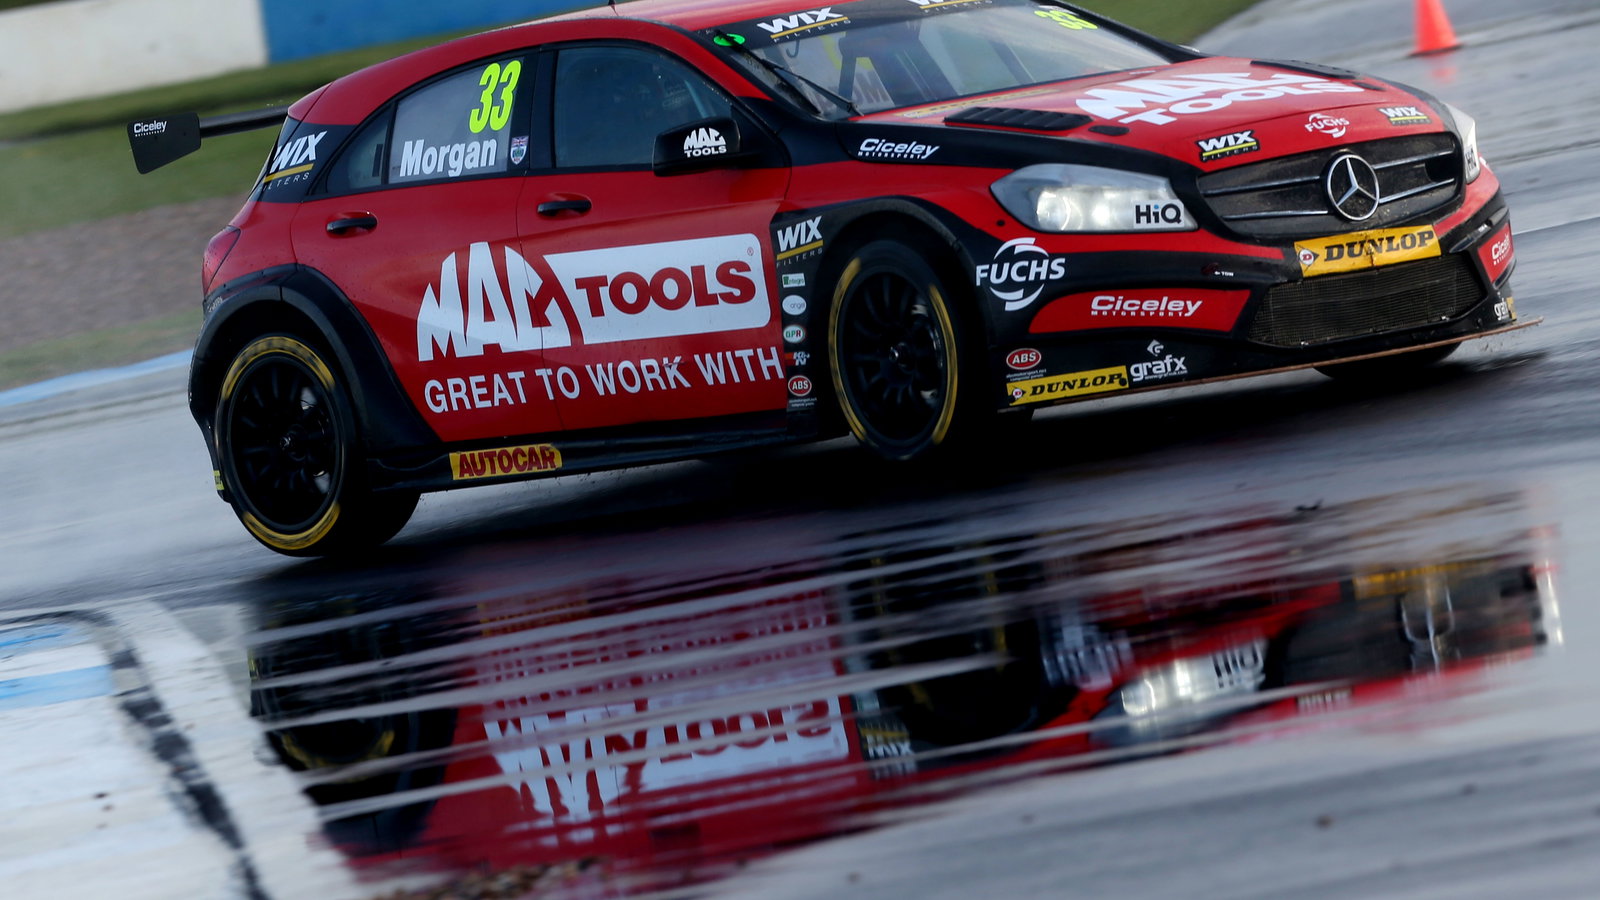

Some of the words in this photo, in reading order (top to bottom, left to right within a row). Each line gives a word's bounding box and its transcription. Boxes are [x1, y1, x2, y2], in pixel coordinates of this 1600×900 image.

[757, 7, 843, 33] WIX
[469, 60, 521, 133] 33
[1076, 73, 1331, 120] MAC
[1118, 81, 1365, 126] TOOLS
[1305, 117, 1350, 133] FUCHS
[1379, 106, 1425, 117] WIX
[134, 119, 167, 134] Ciceley
[684, 127, 726, 151] MAC
[269, 130, 328, 174] WIX
[684, 145, 727, 158] TOOLS
[860, 138, 940, 159] Ciceley
[1198, 130, 1256, 151] WIX
[400, 138, 497, 177] Morgan
[1135, 203, 1182, 224] HiQ
[776, 215, 823, 252] WIX
[1324, 230, 1434, 262] DUNLOP
[976, 257, 1066, 286] FUCHS
[417, 241, 572, 362] MAC
[575, 260, 756, 318] TOOLS
[1091, 295, 1203, 317] Ciceley
[1012, 351, 1037, 364] ABS
[1130, 354, 1188, 383] grafx
[424, 370, 527, 414] GREAT
[535, 363, 581, 402] TO
[585, 355, 692, 397] WORK
[694, 346, 785, 387] WITH
[792, 380, 809, 391] ABS
[1030, 373, 1123, 397] DUNLOP
[458, 446, 557, 479] AUTOCAR
